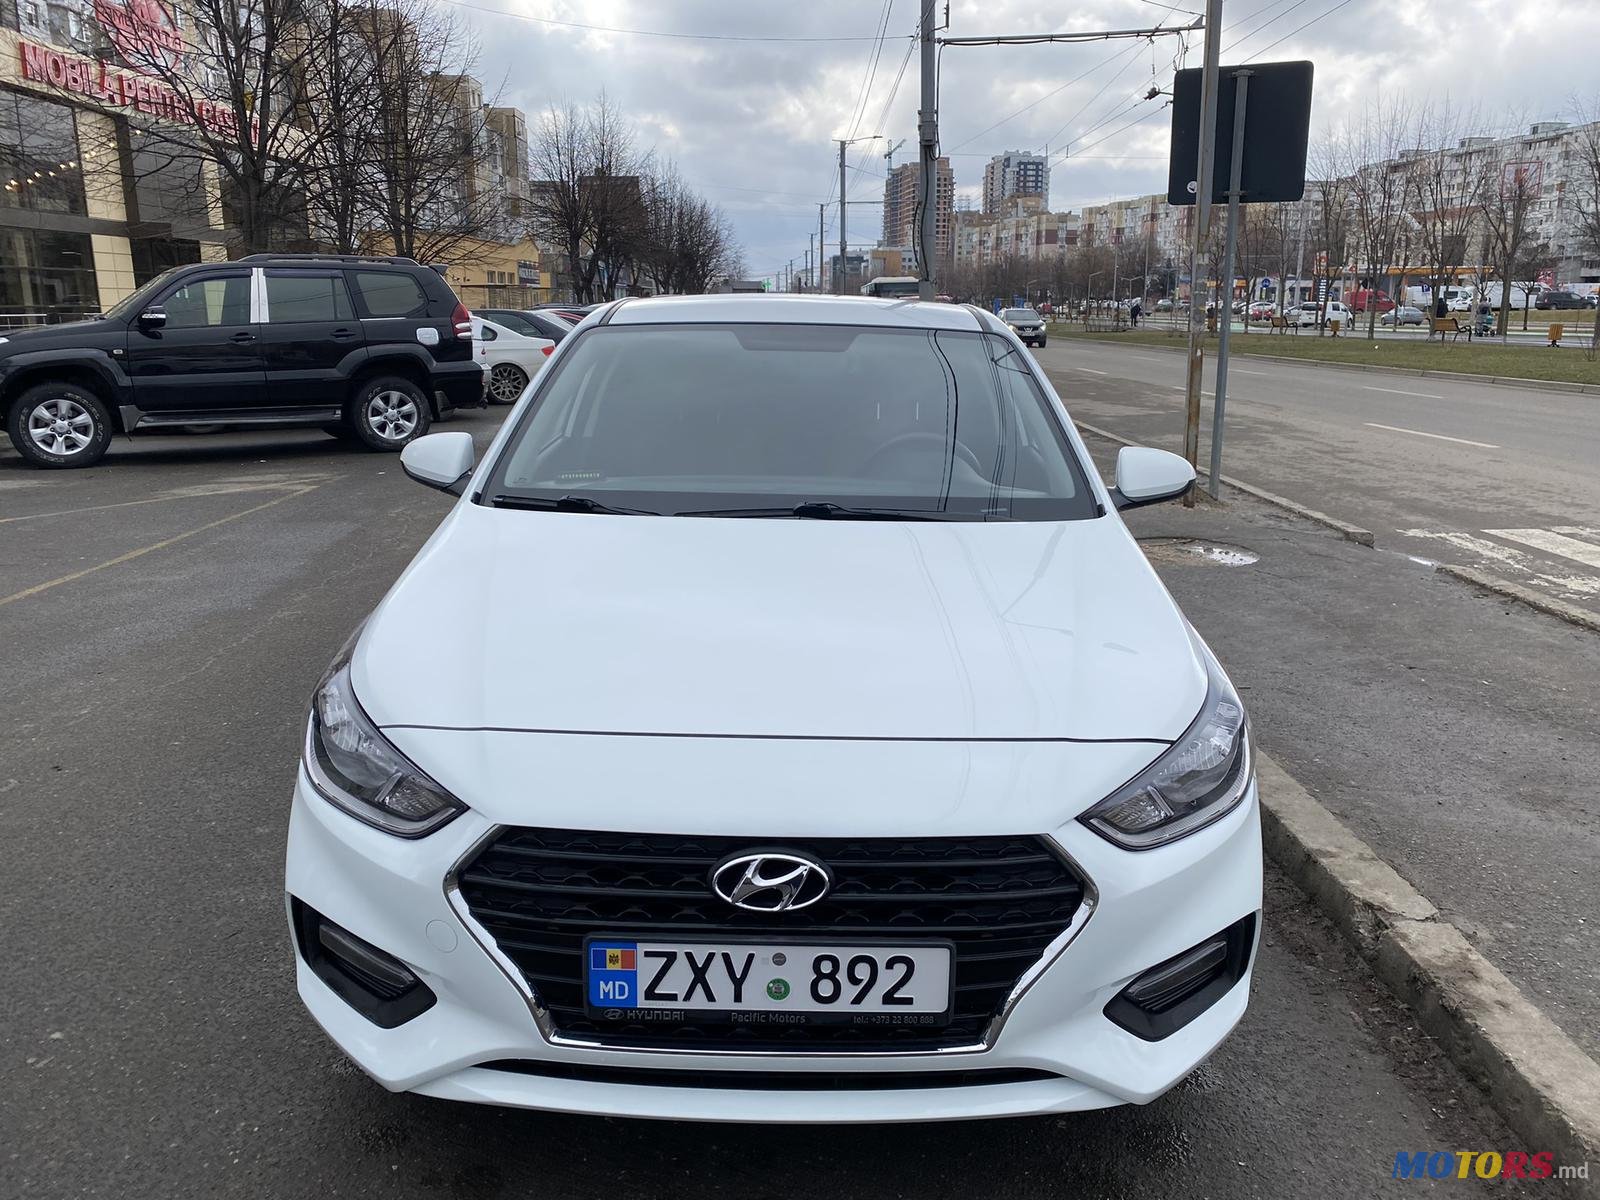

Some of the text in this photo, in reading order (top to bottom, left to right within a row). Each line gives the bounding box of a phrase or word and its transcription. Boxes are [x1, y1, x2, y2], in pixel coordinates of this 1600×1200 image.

[644, 951, 915, 1005] ZXY 892
[600, 981, 628, 999] MD
[627, 1011, 685, 1021] HYUNDAI
[731, 1013, 806, 1024] Pacific Motors
[892, 1016, 902, 1024] 22
